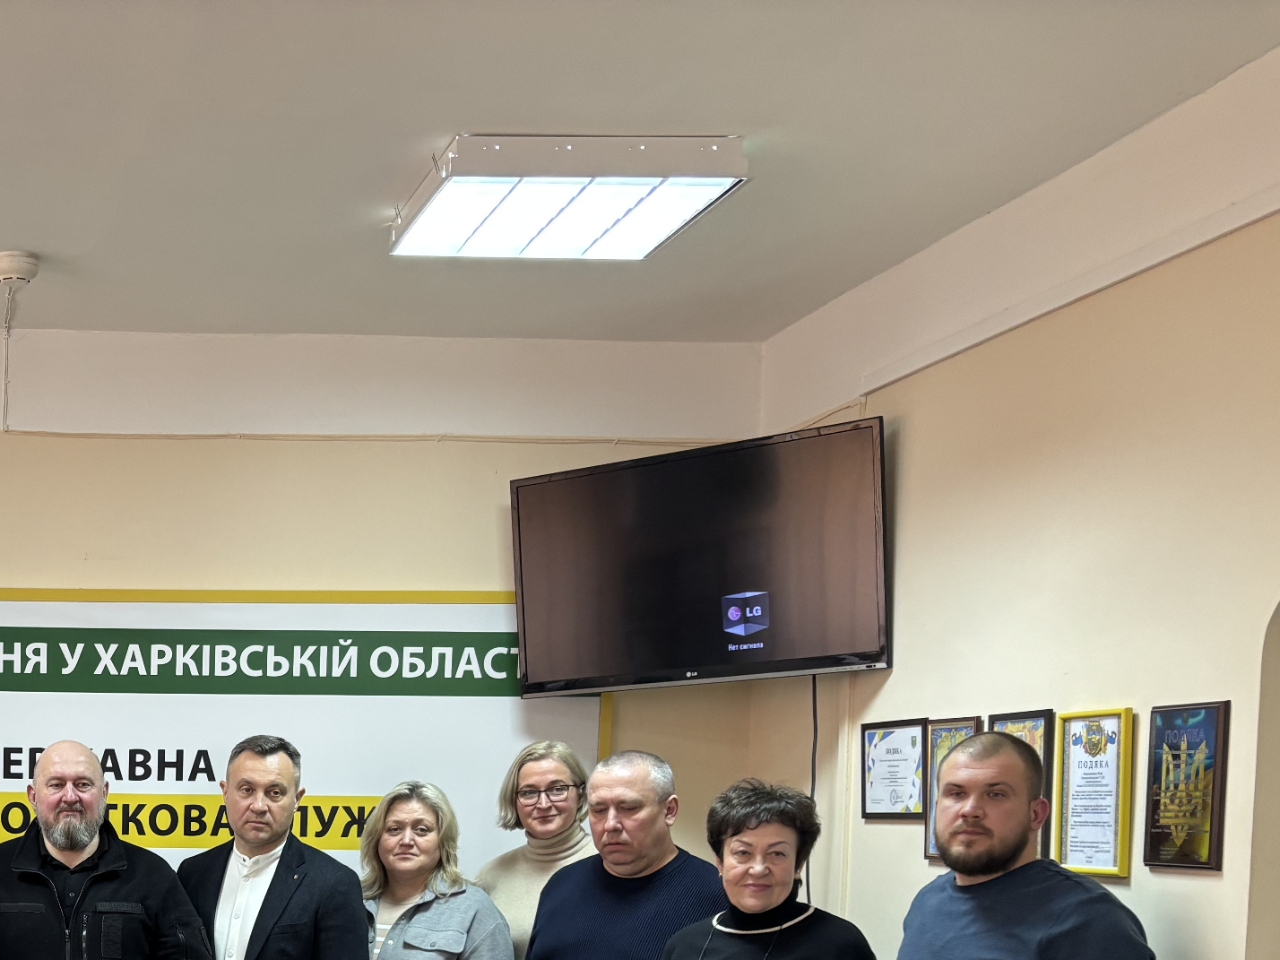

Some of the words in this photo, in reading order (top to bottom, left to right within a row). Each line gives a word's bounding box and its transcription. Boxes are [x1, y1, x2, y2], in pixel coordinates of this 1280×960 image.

[746, 606, 762, 617] LG
[728, 643, 739, 652] Нет
[59, 643, 84, 675] У
[93, 638, 358, 678] ХАРКІВСЬКІЙ
[369, 646, 521, 679] ОБЛАСТ
[1164, 728, 1206, 745] ПОДЯКА
[1077, 760, 1110, 770] ПОДЯКА
